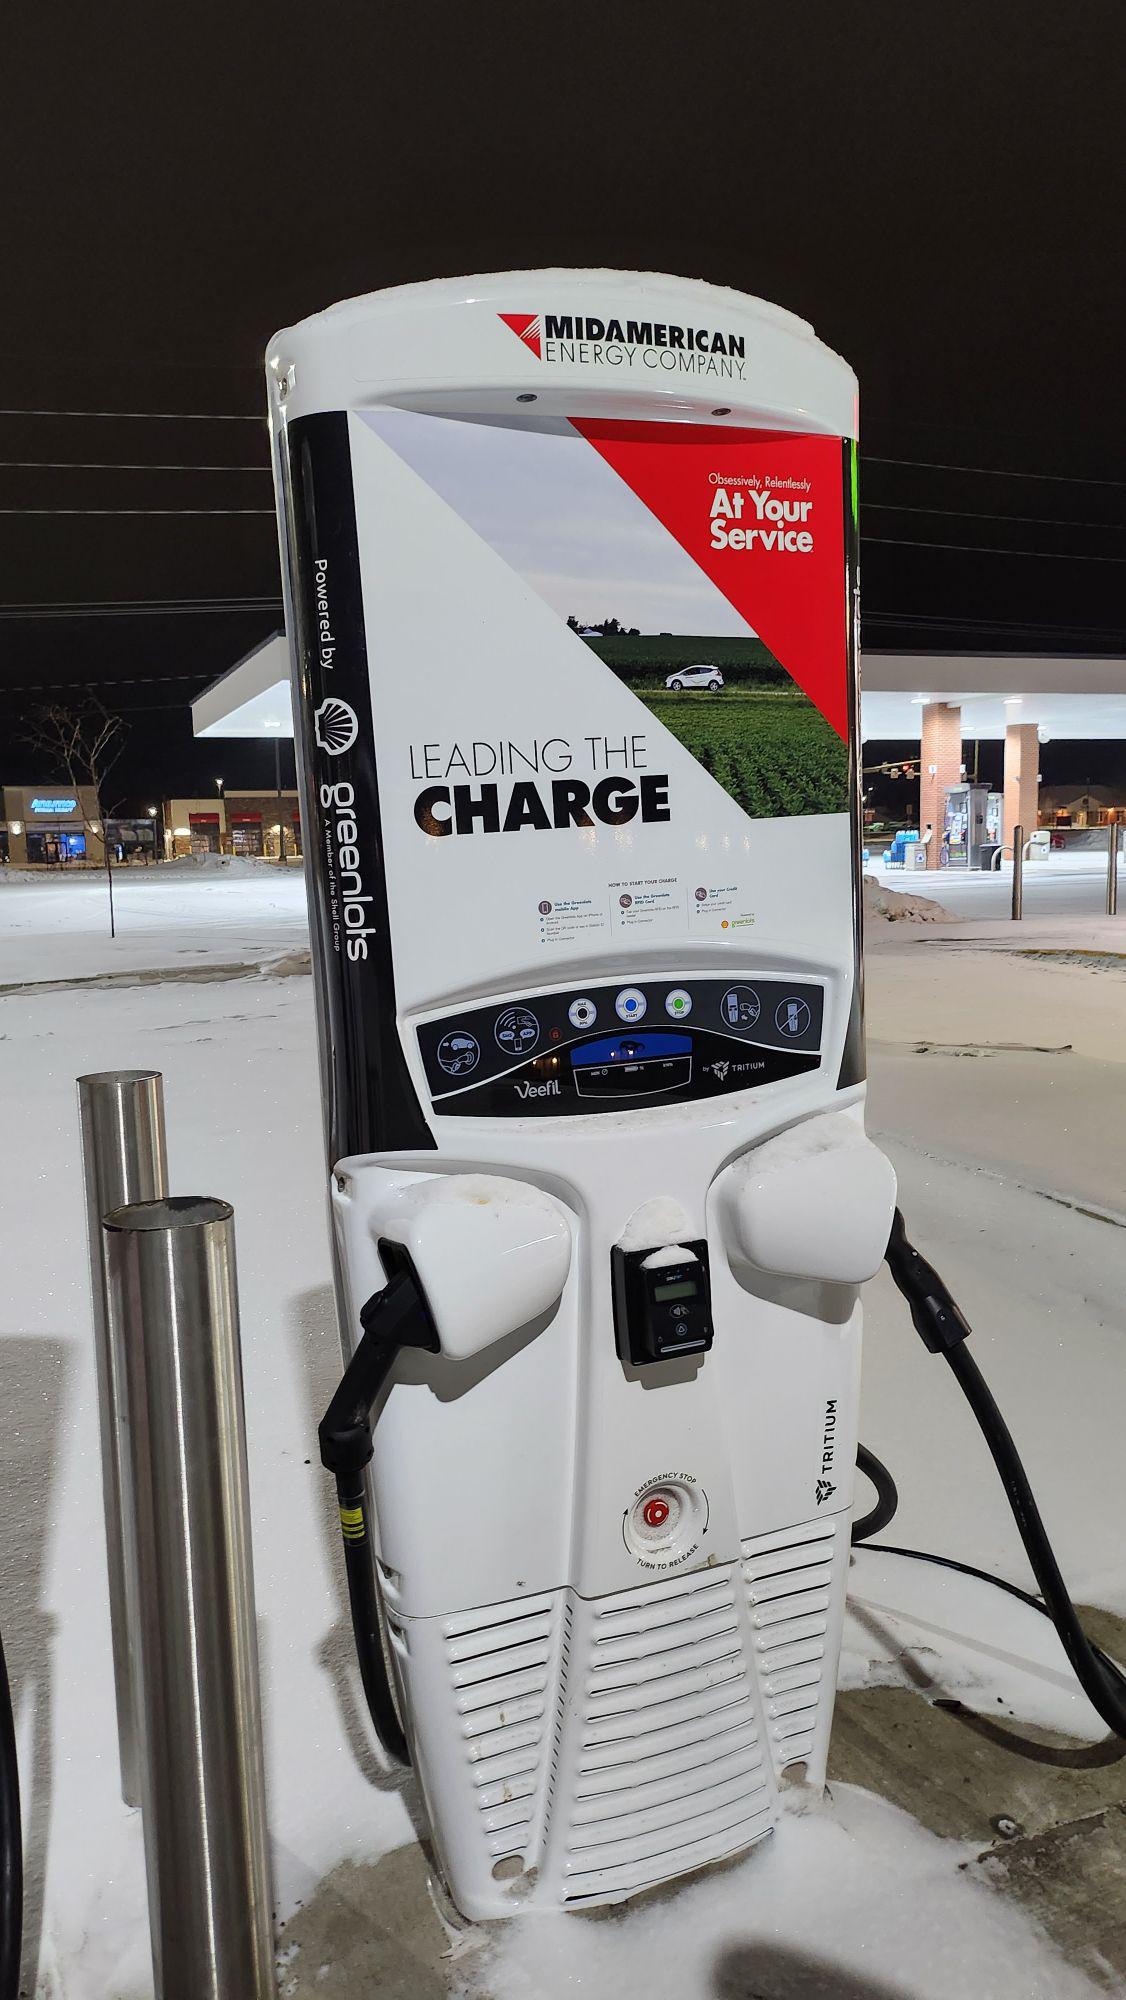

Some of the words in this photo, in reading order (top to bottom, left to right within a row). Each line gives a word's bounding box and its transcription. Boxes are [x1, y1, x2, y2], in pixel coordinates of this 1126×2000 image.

[545, 315, 745, 358] MIDAMERICAN
[546, 341, 637, 366] ENERGY
[708, 472, 763, 489] Obsessively,
[765, 476, 811, 493] Relentlessly
[709, 488, 744, 519] At
[748, 490, 813, 522] Your
[710, 518, 814, 552] Service
[314, 559, 336, 642] Powered
[320, 647, 336, 669] by
[409, 738, 573, 780] LEADING
[585, 735, 647, 771] THE
[413, 774, 671, 837] CHARGE
[324, 819, 331, 827] A
[325, 829, 334, 867] Member
[320, 782, 376, 962] greenlots
[328, 870, 337, 879] of
[331, 899, 339, 920] Shell
[732, 1061, 765, 1072] TRITIUM
[514, 1080, 561, 1099] Veefil
[822, 1400, 837, 1474] TRITIUM
[634, 1472, 678, 1497] EMERGENCY
[679, 1472, 697, 1484] STOP
[637, 1558, 656, 1570] TURN
[669, 1543, 699, 1567] RELEASE
